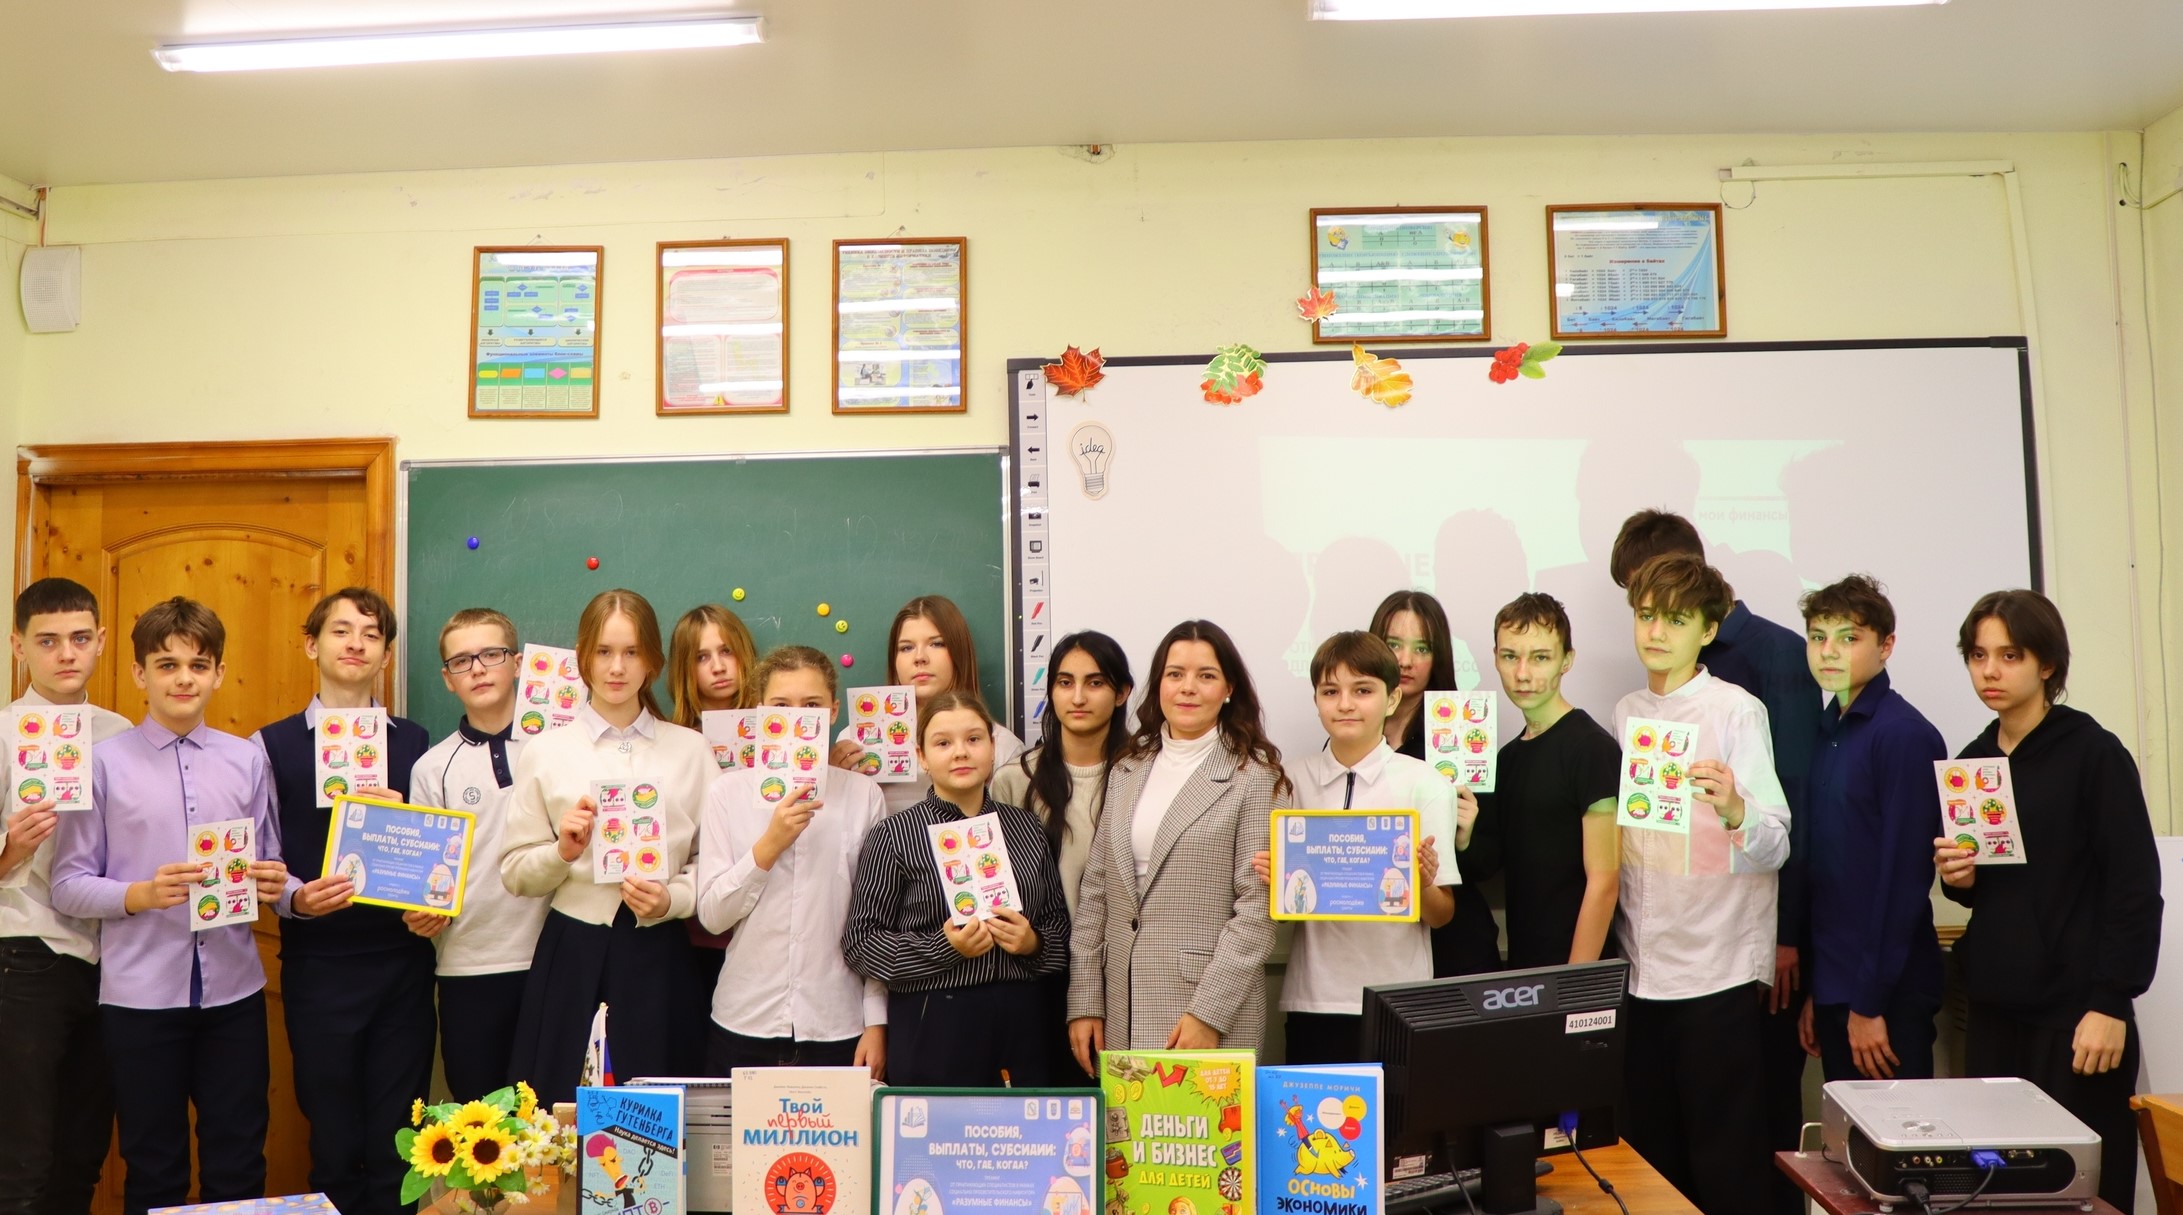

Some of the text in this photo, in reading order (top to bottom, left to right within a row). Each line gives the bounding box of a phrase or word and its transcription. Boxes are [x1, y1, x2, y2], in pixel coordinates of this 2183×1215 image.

[1079, 437, 1105, 457] idea
[1729, 506, 1789, 529] финансы
[385, 824, 421, 838] ПОСОБИЯ,
[1328, 834, 1367, 844] ПОСОБИЯ,
[362, 832, 440, 852] ВЫПЛАТЫ, СУБСИДИИ:
[1306, 845, 1388, 855] ВЫПЛАТЫ, СУБСИДИИ:
[1349, 856, 1370, 864] КОГДА?
[1483, 984, 1545, 1009] acer
[1568, 1015, 1613, 1030] 410124001
[1282, 1081, 1361, 1092] ДЖУЗЕППЕ МОРИЧИ
[620, 1097, 663, 1122] КУРИЛКА
[779, 1098, 823, 1113] Твой
[616, 1110, 674, 1141] ГУТЕНБЕРГА
[767, 1109, 834, 1139] первый
[964, 1125, 1023, 1140] ПОСОБИЯ,
[1139, 1113, 1209, 1140] ДЕНЬГИ
[614, 1126, 676, 1155] Наука делается здесь!
[743, 1129, 859, 1146] МИЛЛИОН
[928, 1142, 1057, 1158] ВЫПЛАТЫ, СУБСИДИИ:
[1132, 1141, 1218, 1169] И БИЗНЕС
[955, 1159, 1029, 1170] ЧТО, ГДЕ, КОГДА?
[1139, 1171, 1212, 1189] ДЛЯ ДЕТЕЙ
[1287, 1178, 1356, 1199] ОСНОВЫ
[952, 1197, 1032, 1207] «РАЗУМНЫЕ ФИНАНСЫ»
[1277, 1196, 1367, 1215] ЭКОНОМИКИ
